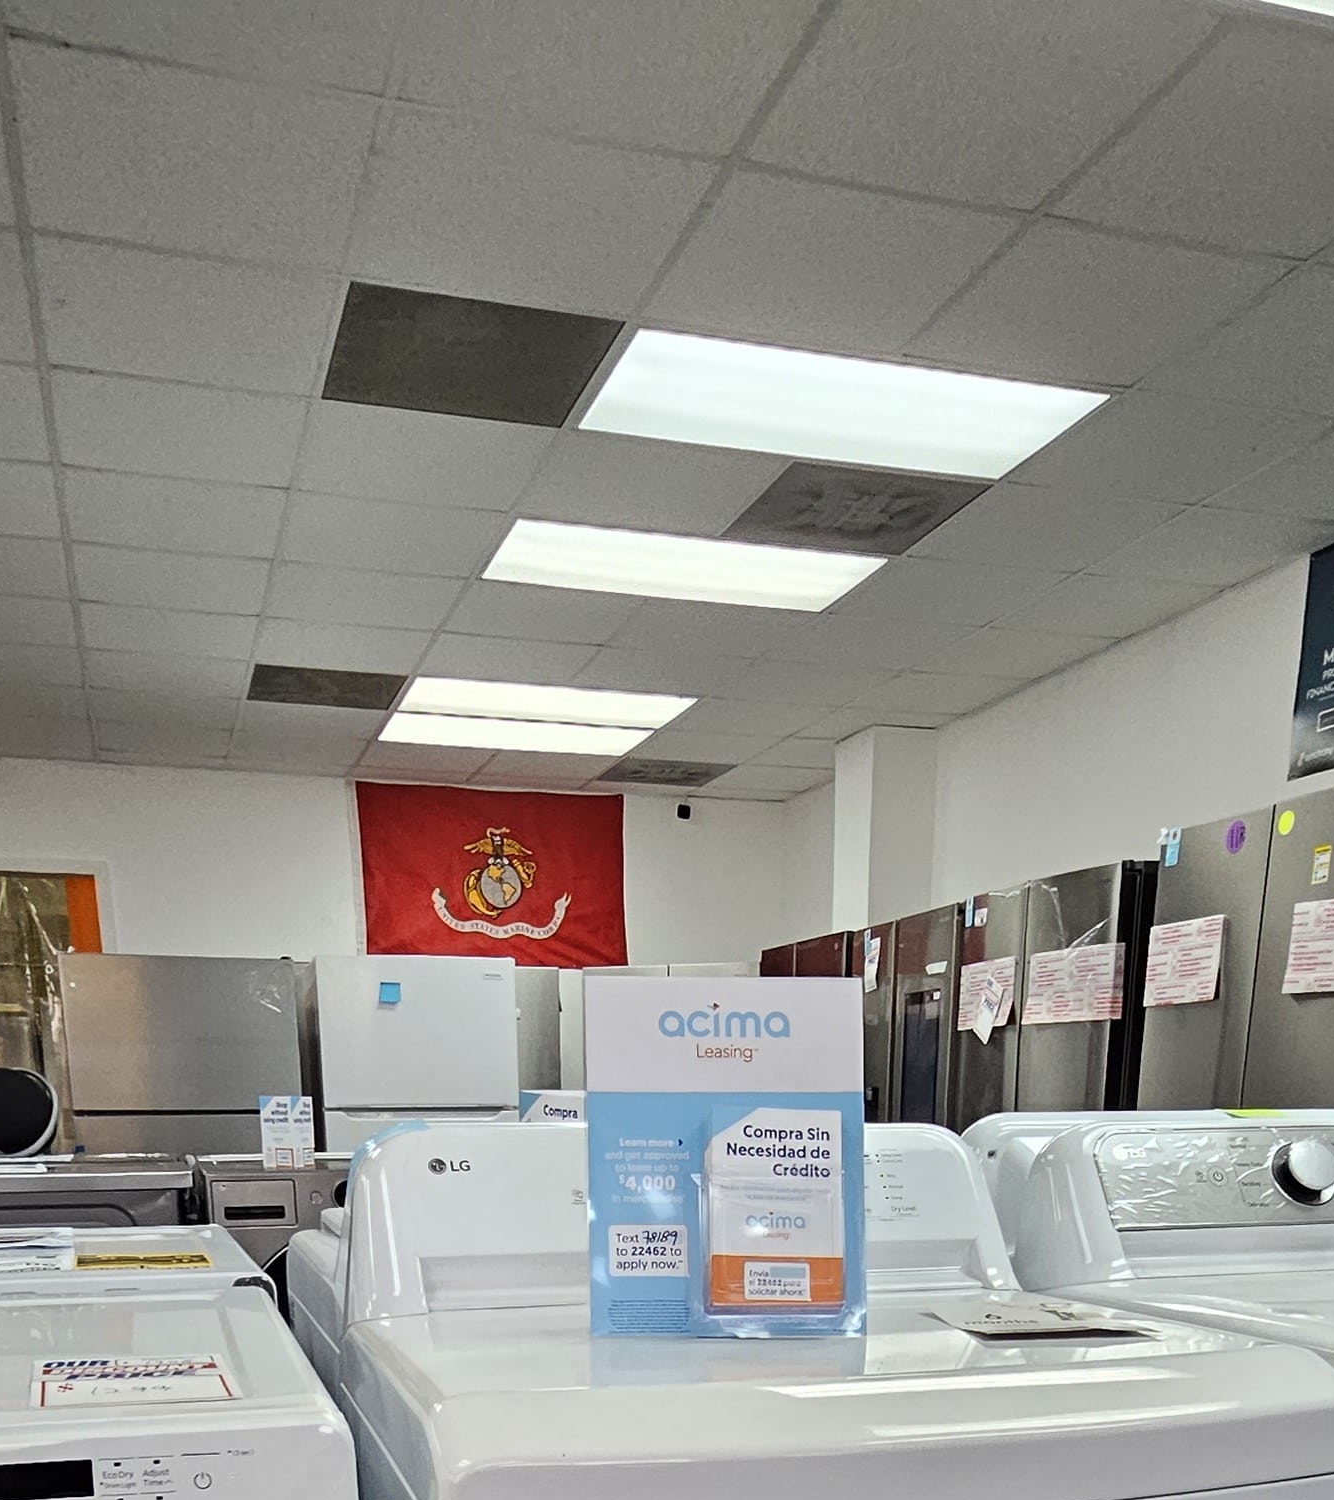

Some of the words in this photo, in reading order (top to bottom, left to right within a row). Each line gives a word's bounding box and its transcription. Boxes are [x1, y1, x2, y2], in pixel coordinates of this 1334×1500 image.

[658, 1002, 791, 1038] acima
[695, 1043, 754, 1063] Leasing
[543, 1104, 579, 1120] Compra
[742, 1125, 804, 1143] Compra
[807, 1127, 830, 1141] Sin
[726, 1142, 807, 1159] Necesidad
[809, 1146, 830, 1159] de
[450, 1160, 471, 1172] LG
[772, 1163, 831, 1178] Crédito
[618, 1174, 676, 1193] $4,000
[615, 1233, 640, 1244] Text
[616, 1247, 628, 1256] to
[631, 1246, 667, 1256] 22462
[670, 1247, 682, 1257] to
[615, 1260, 648, 1271] apply
[43, 1358, 111, 1369] OUR
[119, 1471, 134, 1480] Dry
[142, 1468, 170, 1478] Adjust
[143, 1479, 164, 1487] Time
